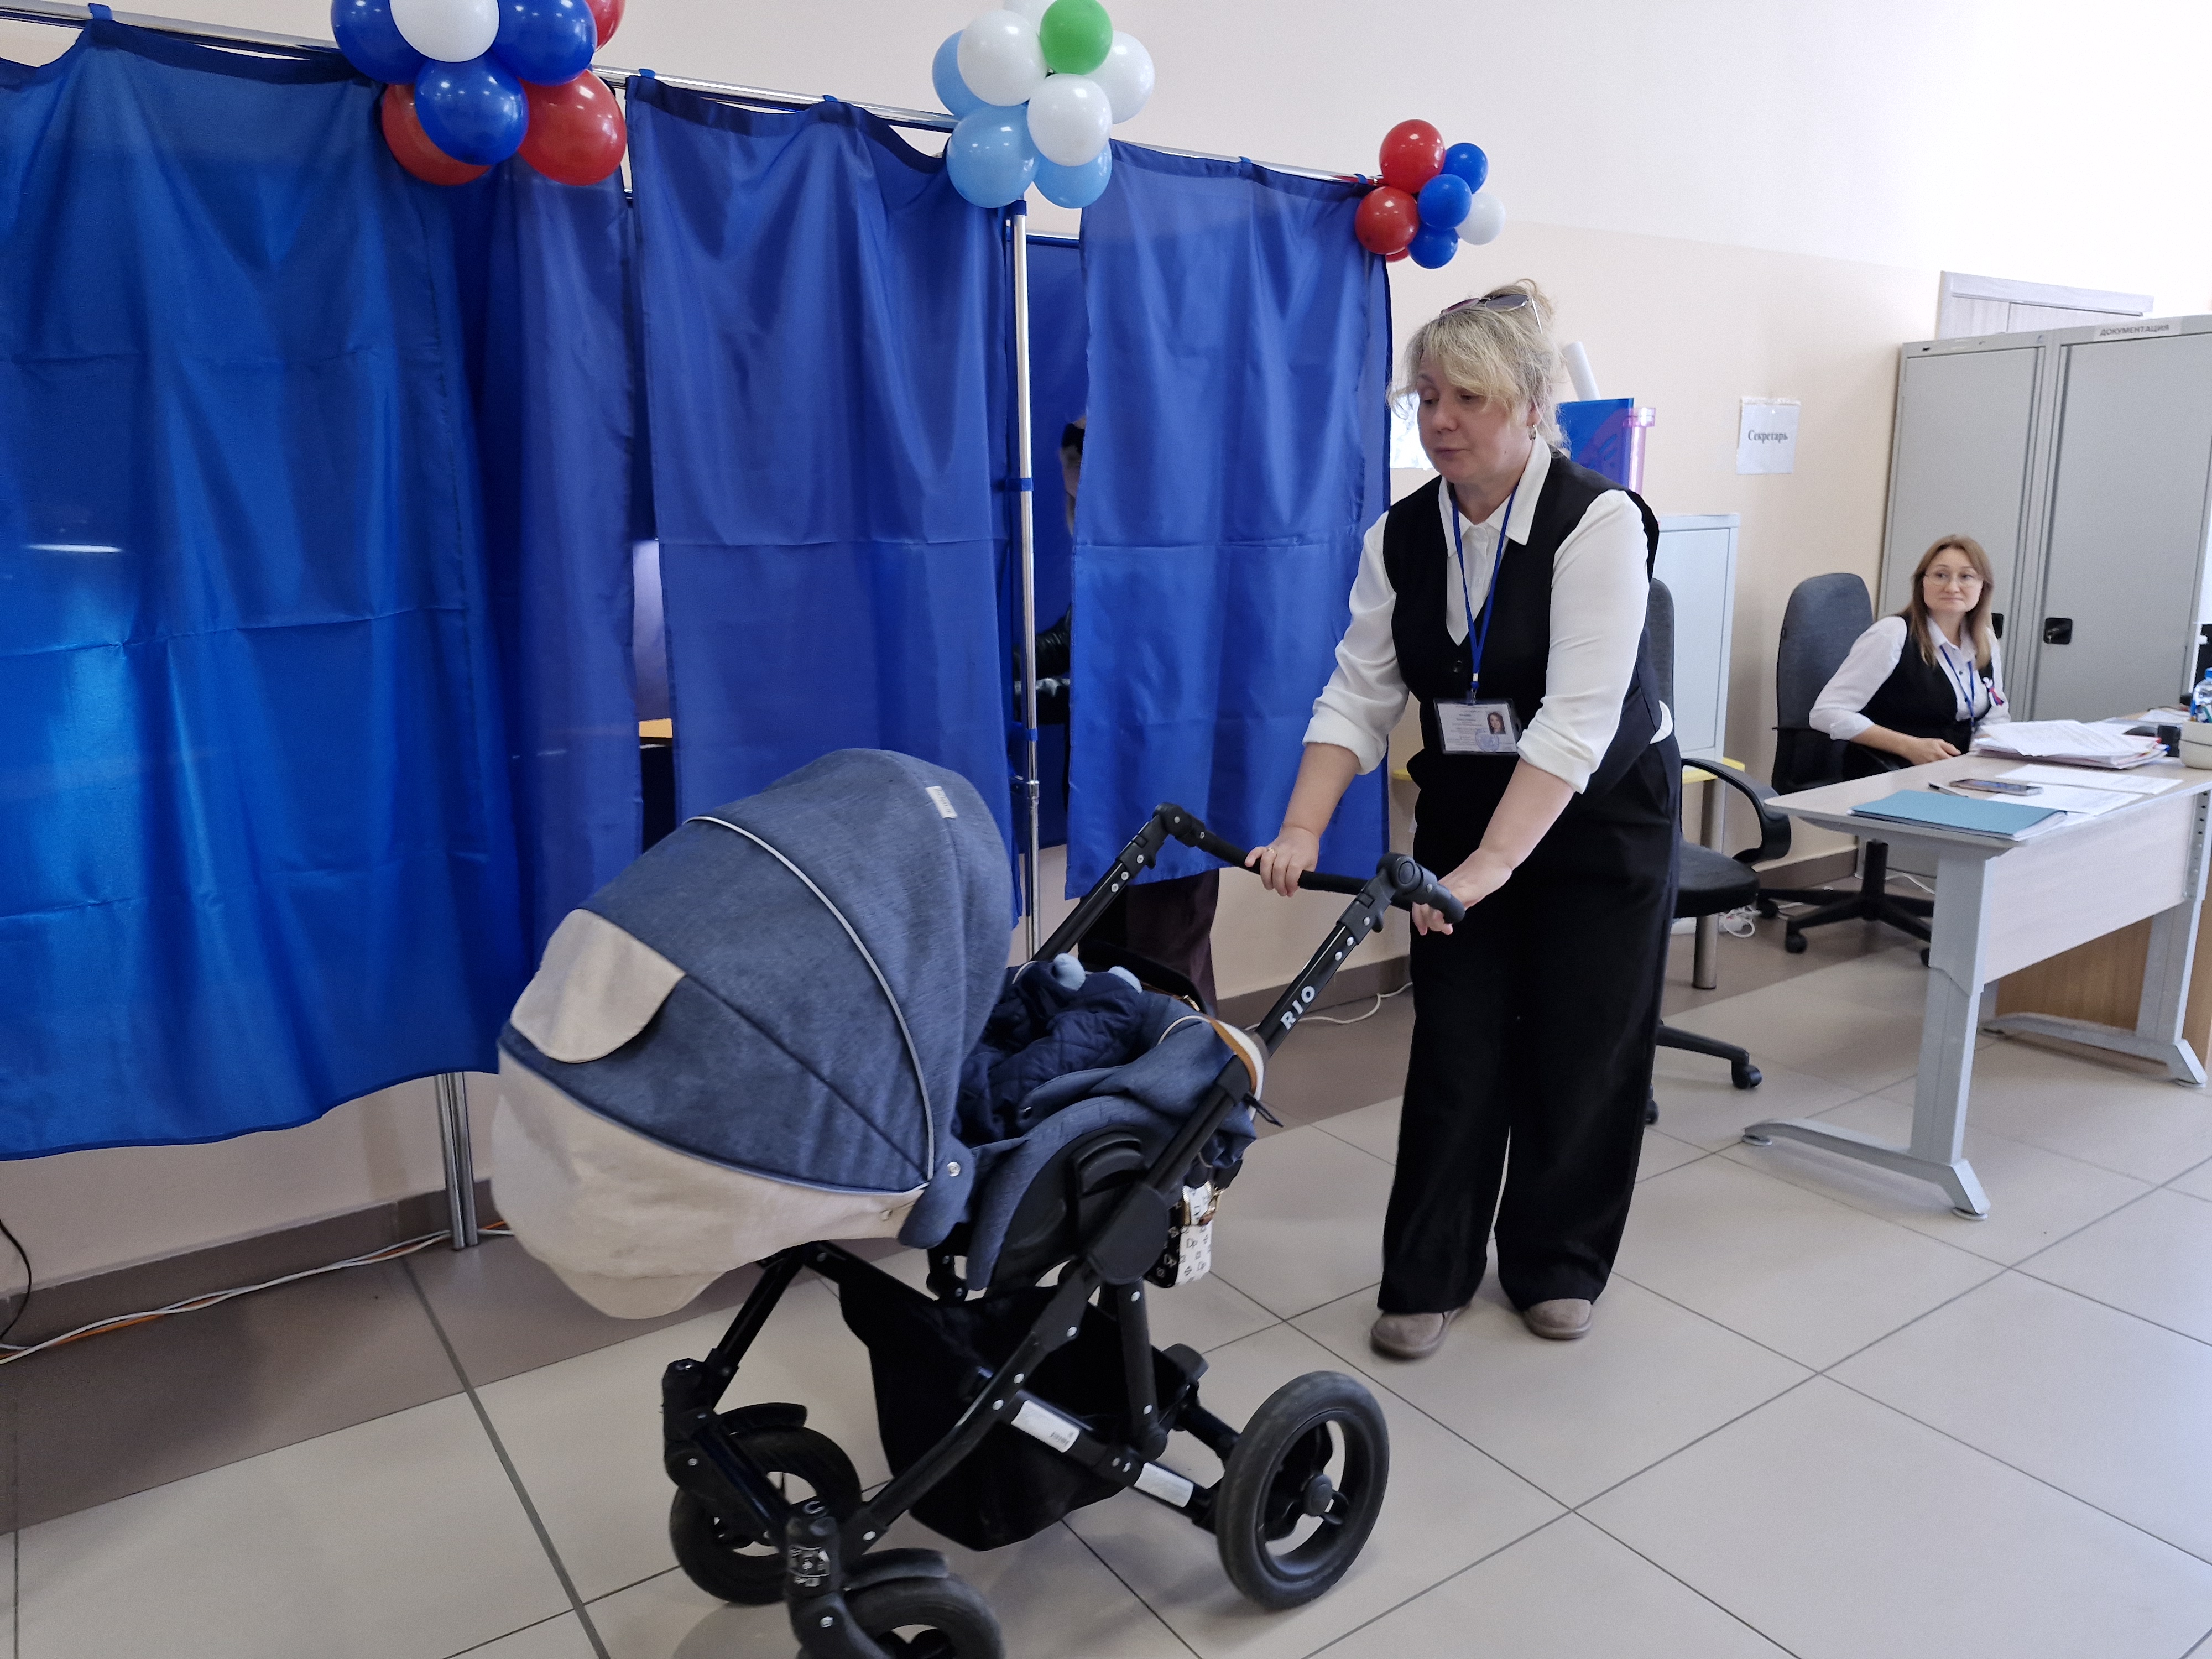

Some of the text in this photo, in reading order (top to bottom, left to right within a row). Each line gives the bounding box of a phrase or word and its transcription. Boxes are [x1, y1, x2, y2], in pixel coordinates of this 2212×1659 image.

[2100, 324, 2169, 336] ДОКУМЕНТАЦИЯ
[1748, 430, 1788, 444] Секретарь
[1280, 985, 1315, 1030] RIO
